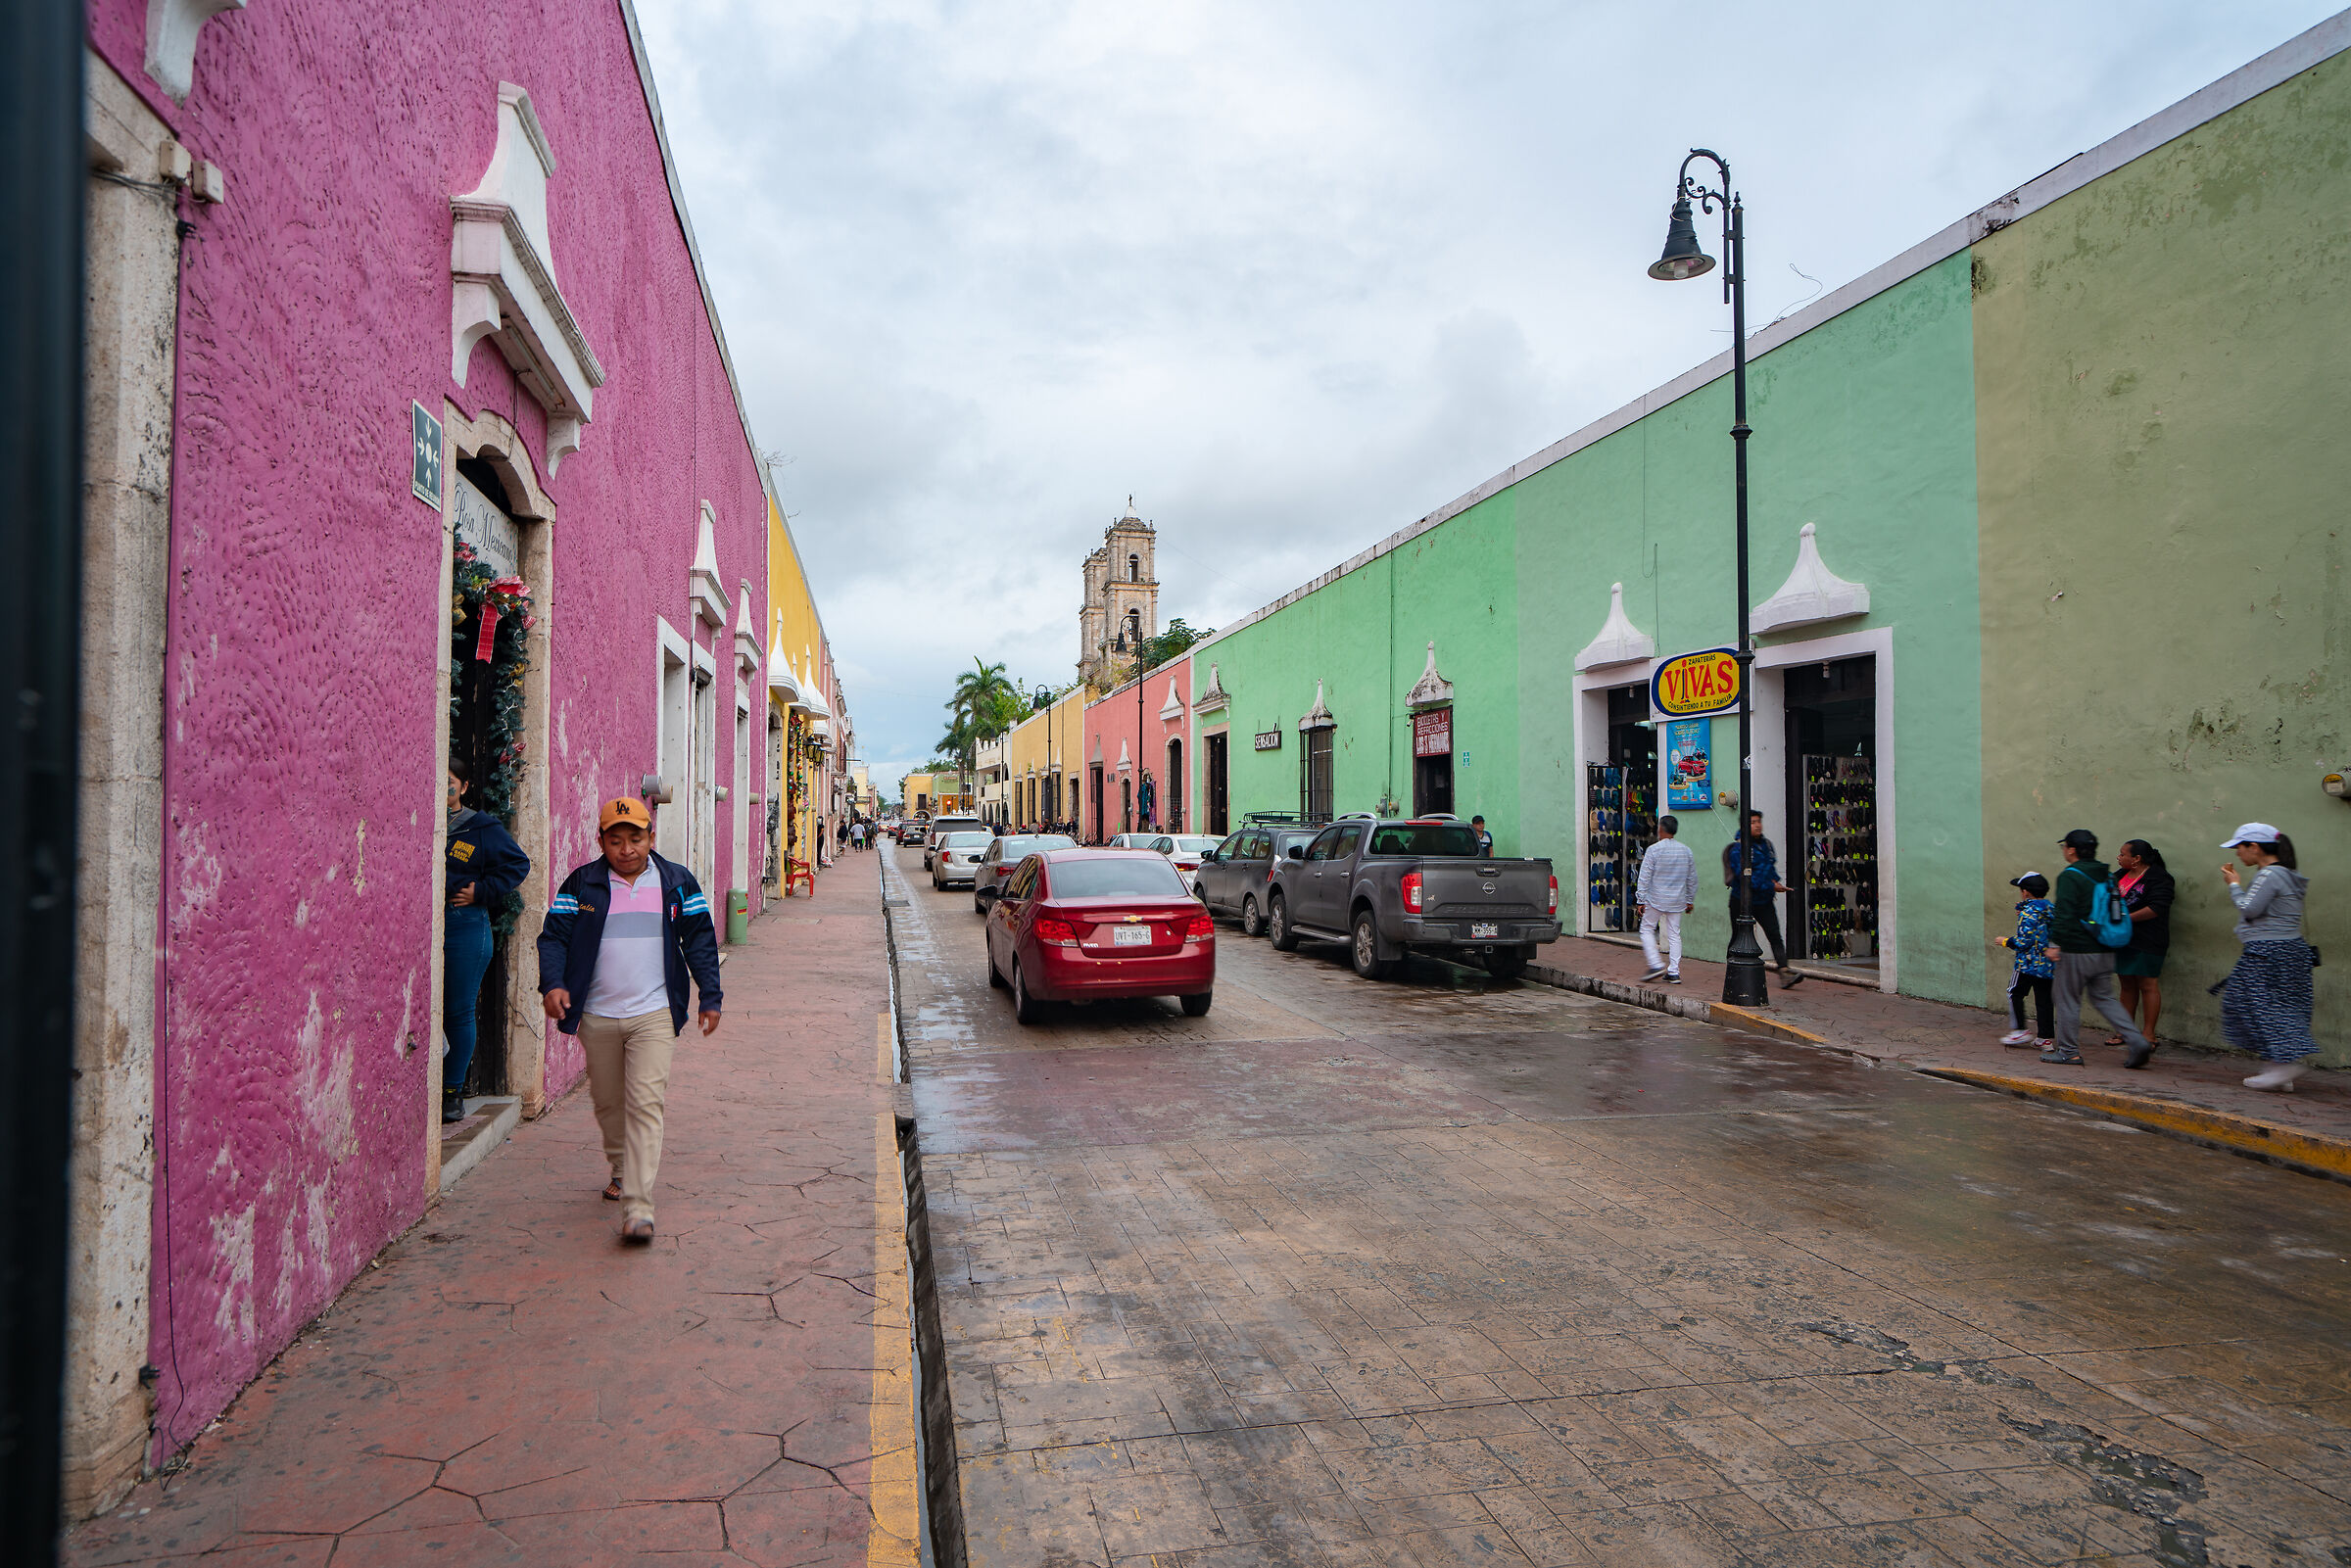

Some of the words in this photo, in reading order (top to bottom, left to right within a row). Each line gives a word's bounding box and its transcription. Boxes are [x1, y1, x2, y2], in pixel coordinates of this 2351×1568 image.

[455, 483, 474, 533] Rosa
[476, 503, 512, 563] Mexicano
[1667, 700, 1700, 711] CONSINTIENDO
[1712, 693, 1733, 706] FAMILIA
[1441, 712, 1446, 722] Y
[1255, 723, 1279, 749] SENSACIÓN
[1416, 721, 1449, 736] REFACCIONES
[615, 800, 630, 815] LA
